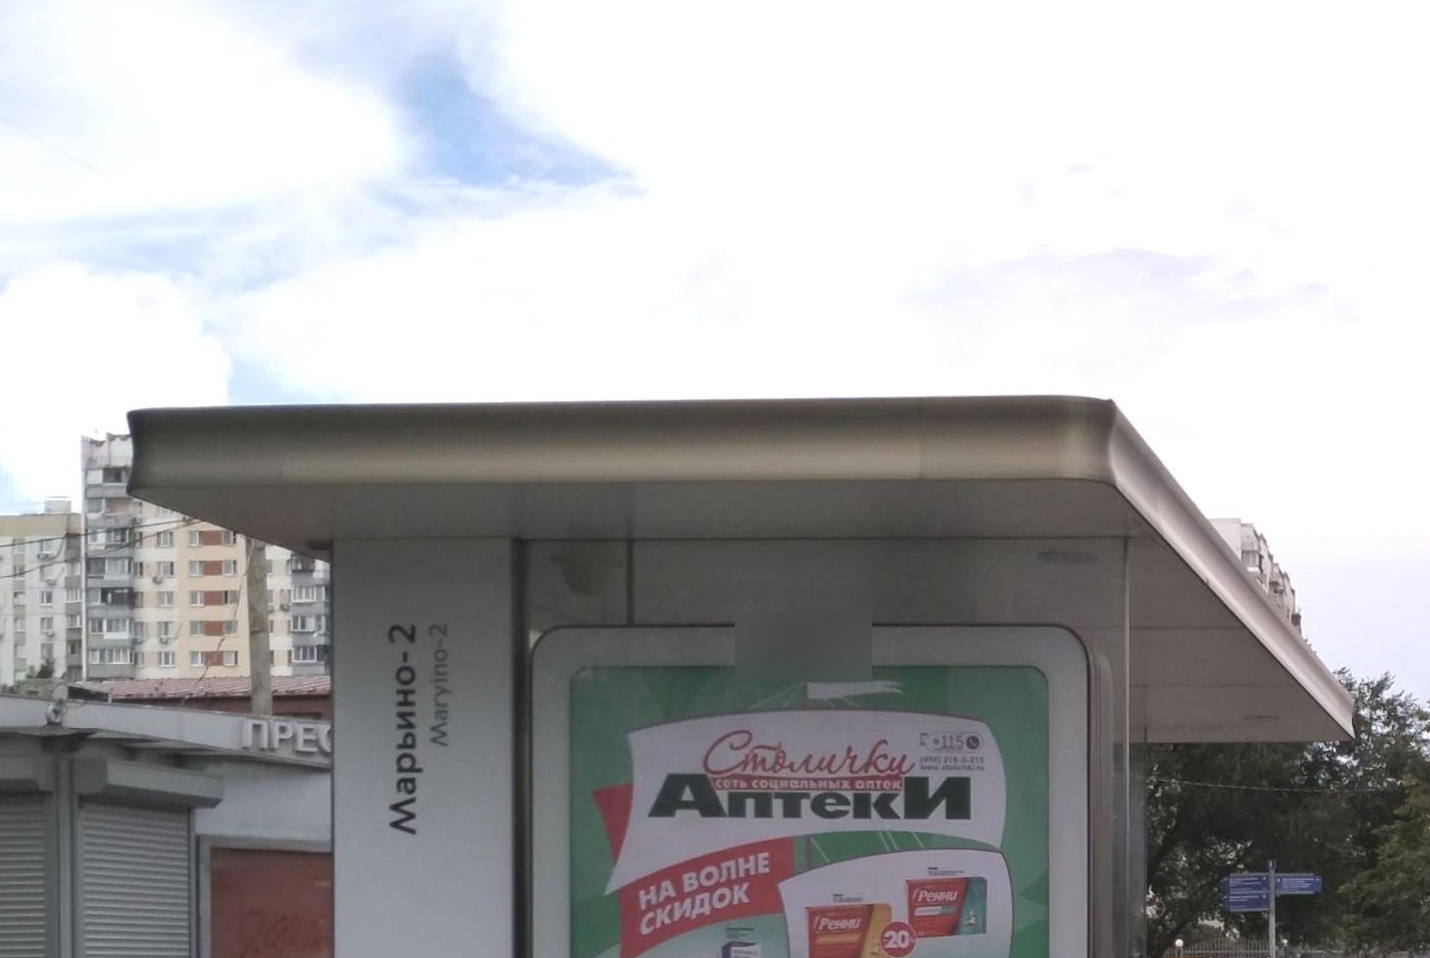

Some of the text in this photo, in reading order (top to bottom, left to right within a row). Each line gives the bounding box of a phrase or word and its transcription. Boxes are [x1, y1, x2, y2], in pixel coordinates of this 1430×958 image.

[428, 623, 452, 747] Maryino-2
[388, 624, 423, 835] Марьино-2
[703, 730, 915, 775] Столички
[715, 779, 903, 791] сеть социальных аптек
[638, 852, 770, 910] НА ВОЛНЕ
[917, 889, 958, 902] Ренни
[640, 882, 749, 935] СКИДОК
[818, 917, 861, 931] Ренни
